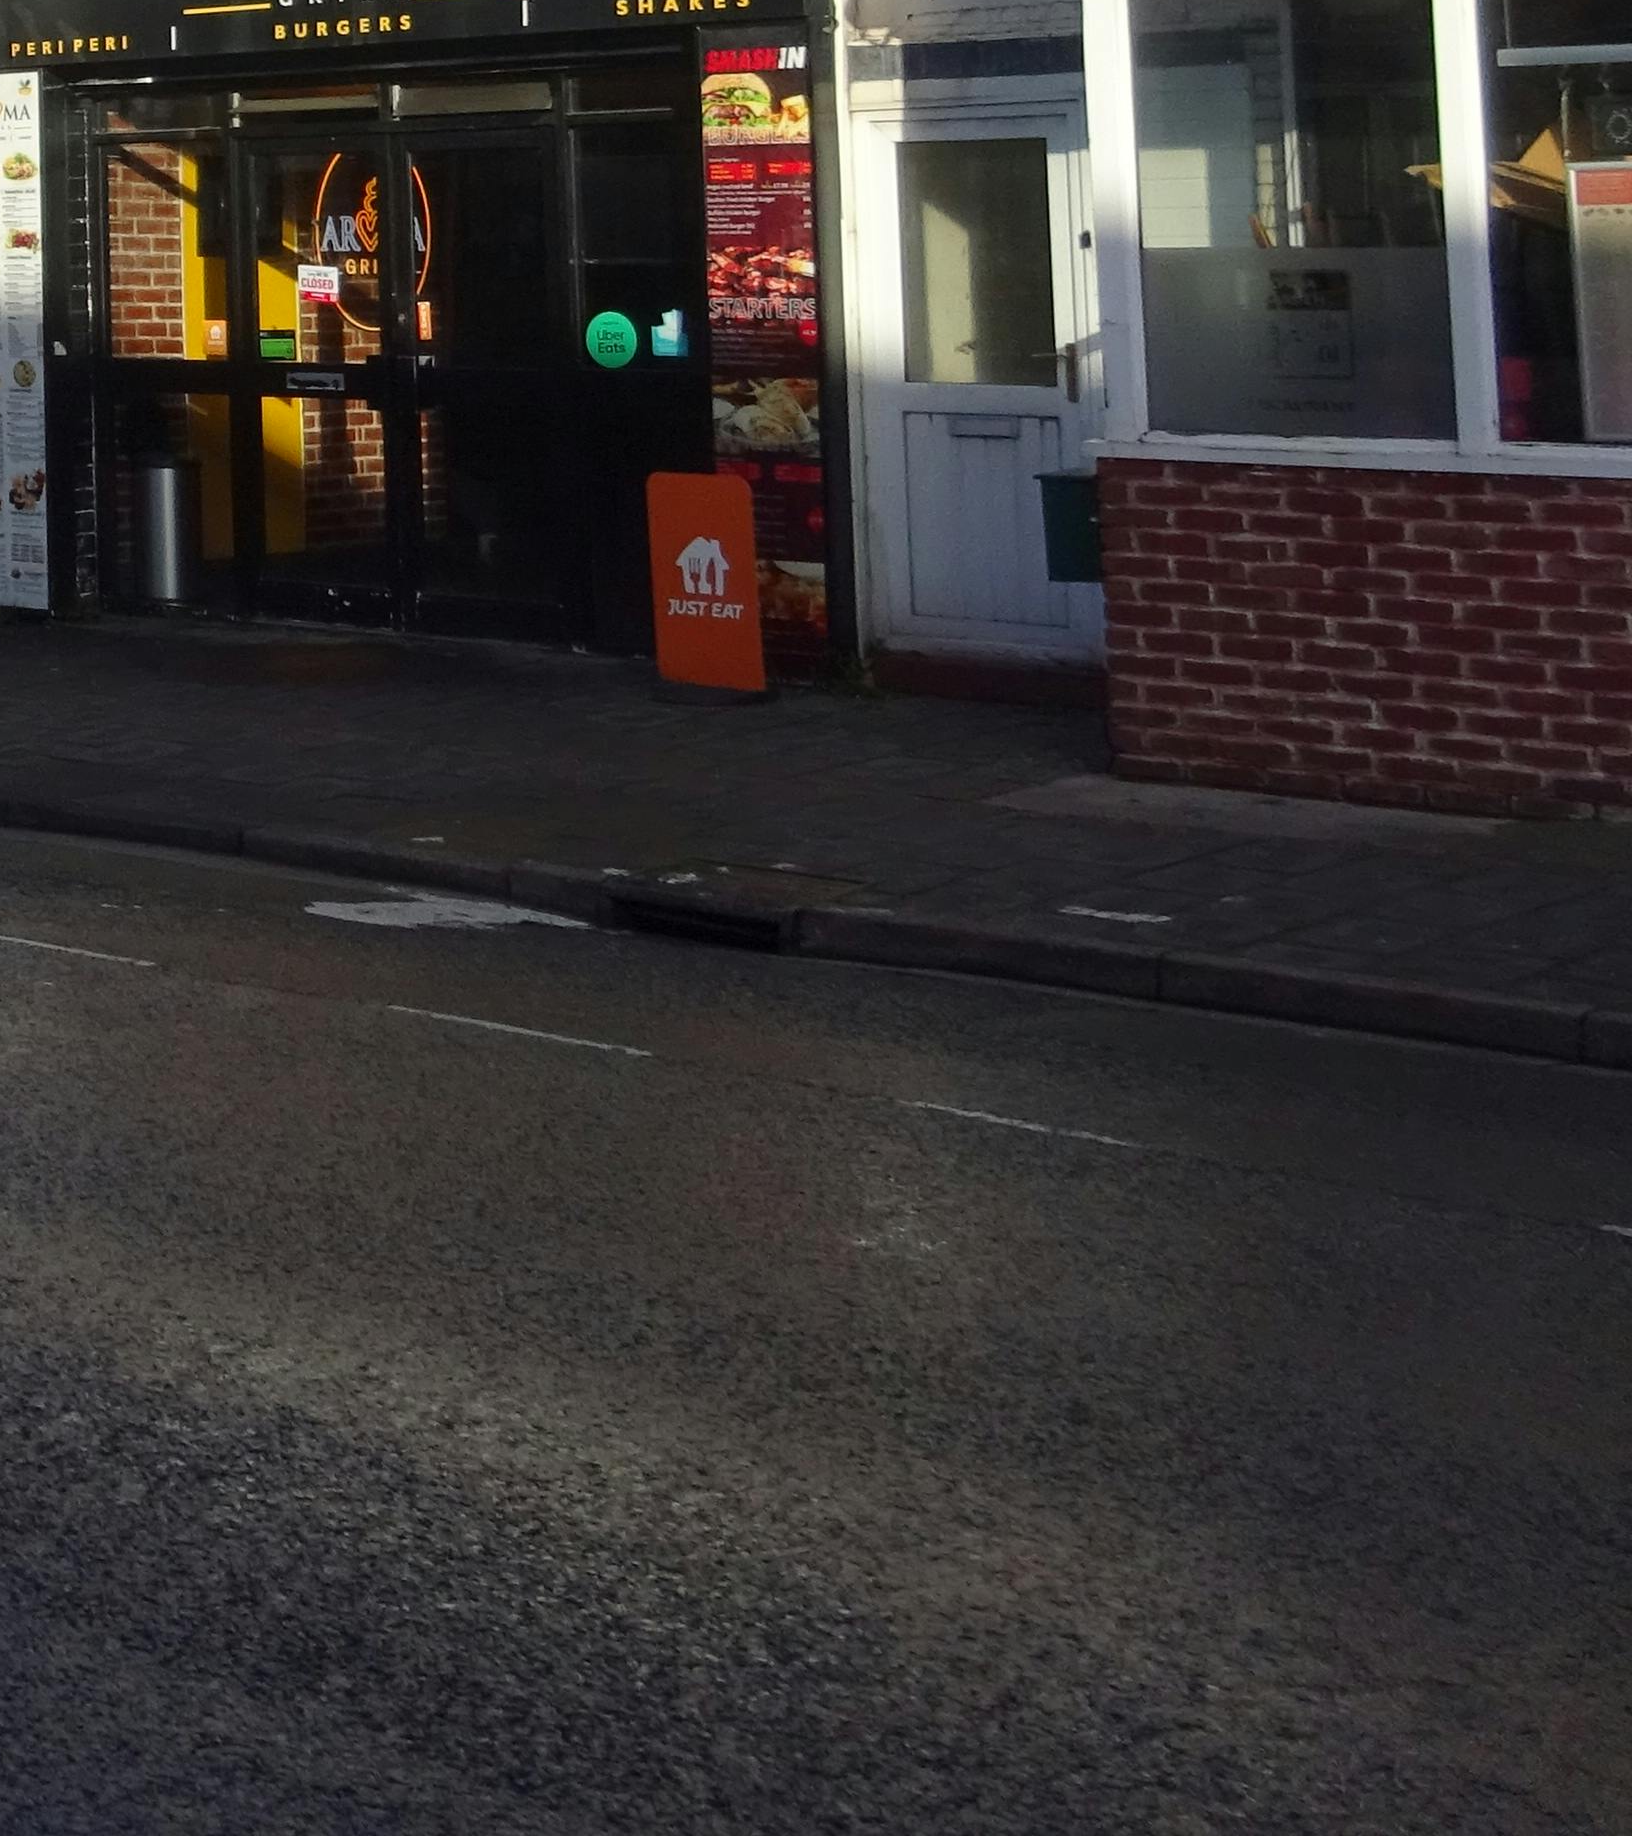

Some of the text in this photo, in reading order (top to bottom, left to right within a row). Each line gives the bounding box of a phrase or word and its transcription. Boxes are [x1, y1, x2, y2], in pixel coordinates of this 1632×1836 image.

[274, 14, 413, 40] BURGERS
[10, 35, 129, 58] PERI PERI
[301, 278, 334, 290] CLOSED
[708, 297, 816, 320] STARTERS
[597, 328, 625, 341] Uber
[598, 342, 626, 354] Eats
[667, 598, 744, 620] JUST EAT
